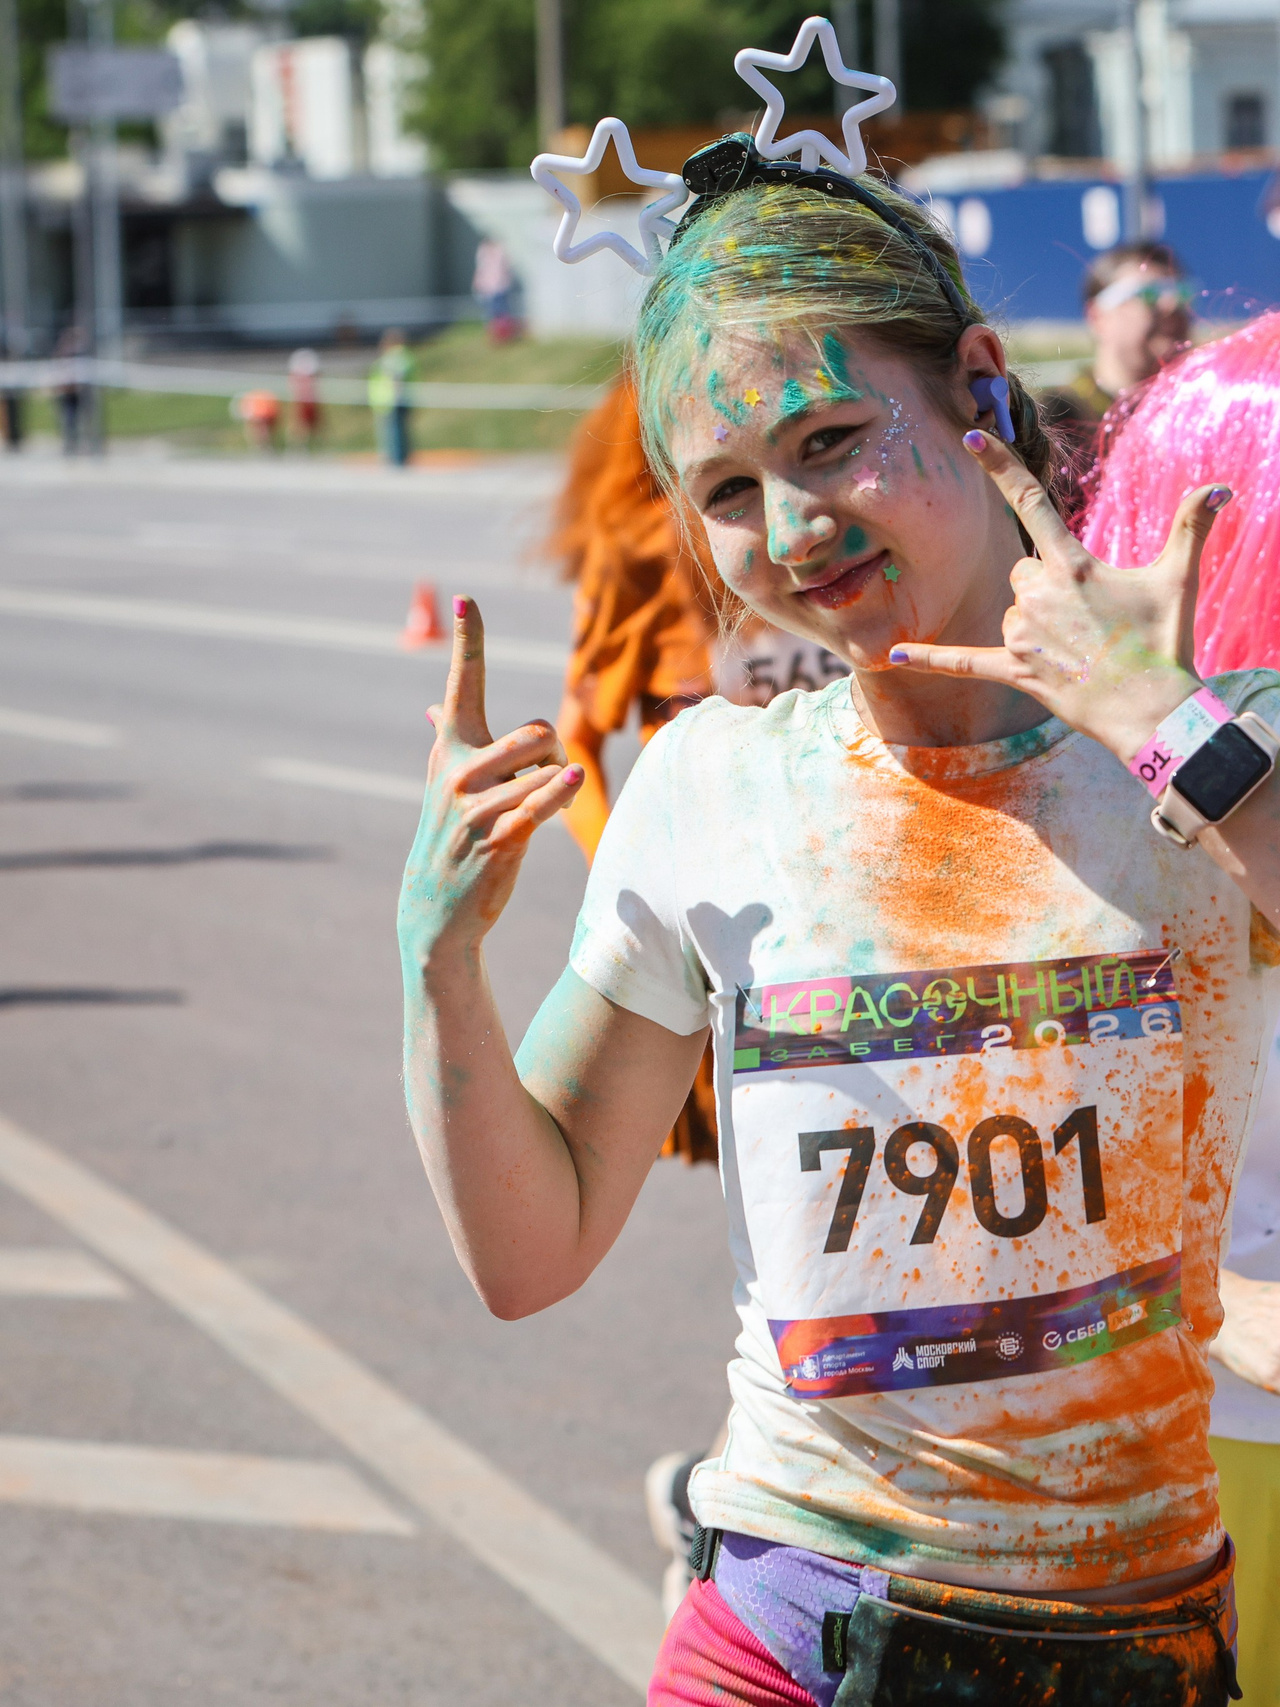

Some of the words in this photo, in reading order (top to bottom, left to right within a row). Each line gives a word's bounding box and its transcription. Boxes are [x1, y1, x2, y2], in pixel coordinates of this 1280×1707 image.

[1138, 750, 1172, 783] 01
[769, 956, 1139, 1038] КРАСОЧНЫЙ
[769, 1034, 955, 1063] ЗАБЕГ
[980, 1006, 1175, 1052] 2026
[797, 1104, 1107, 1254] 7901
[1065, 1320, 1106, 1343] СБЕР
[915, 1338, 977, 1357] МОСКОВСКИЙ
[824, 1368, 848, 1378] города
[848, 1365, 875, 1375] Москвы
[916, 1356, 946, 1370] СПОРТ
